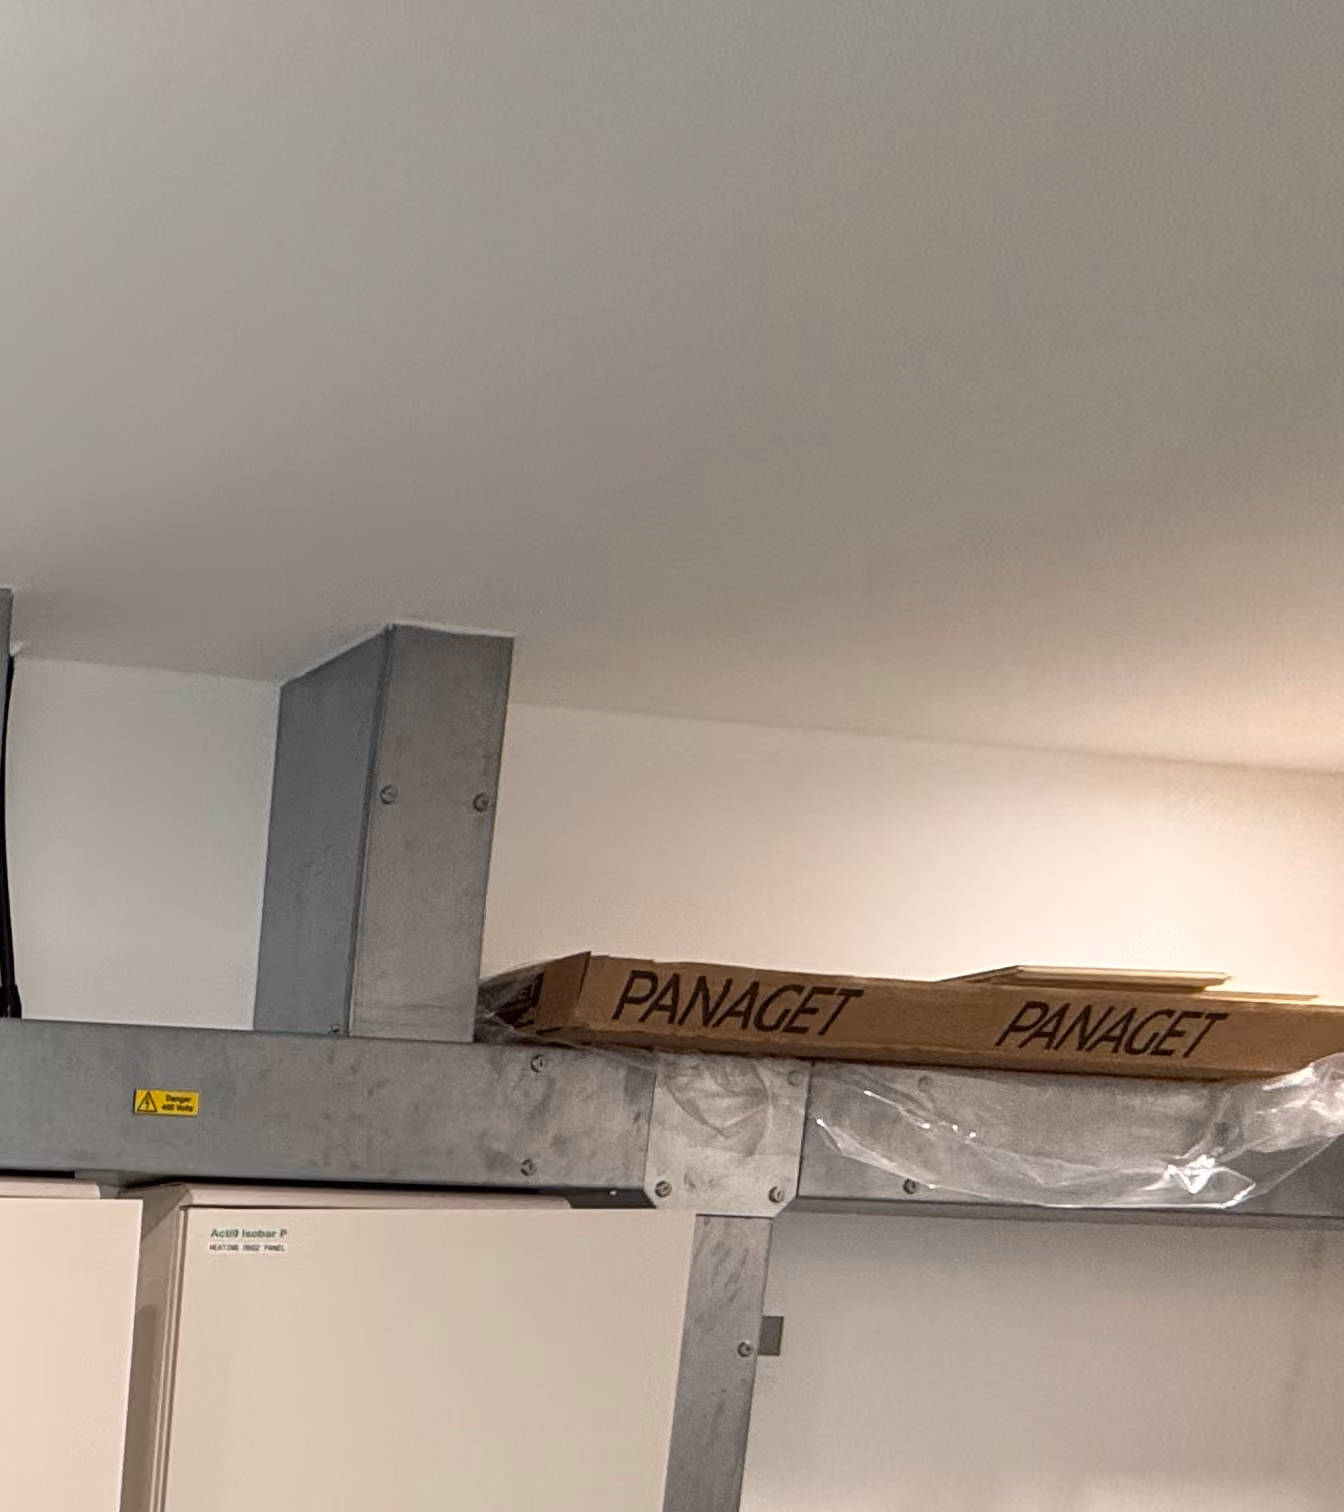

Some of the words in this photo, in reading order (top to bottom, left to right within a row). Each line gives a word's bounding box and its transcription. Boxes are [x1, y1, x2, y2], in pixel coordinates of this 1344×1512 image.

[611, 969, 865, 1036] PANAGET
[993, 1000, 1230, 1058] PANAGET
[165, 1094, 193, 1103] Danger
[241, 1229, 278, 1238] Isobar
[279, 1228, 288, 1238] P
